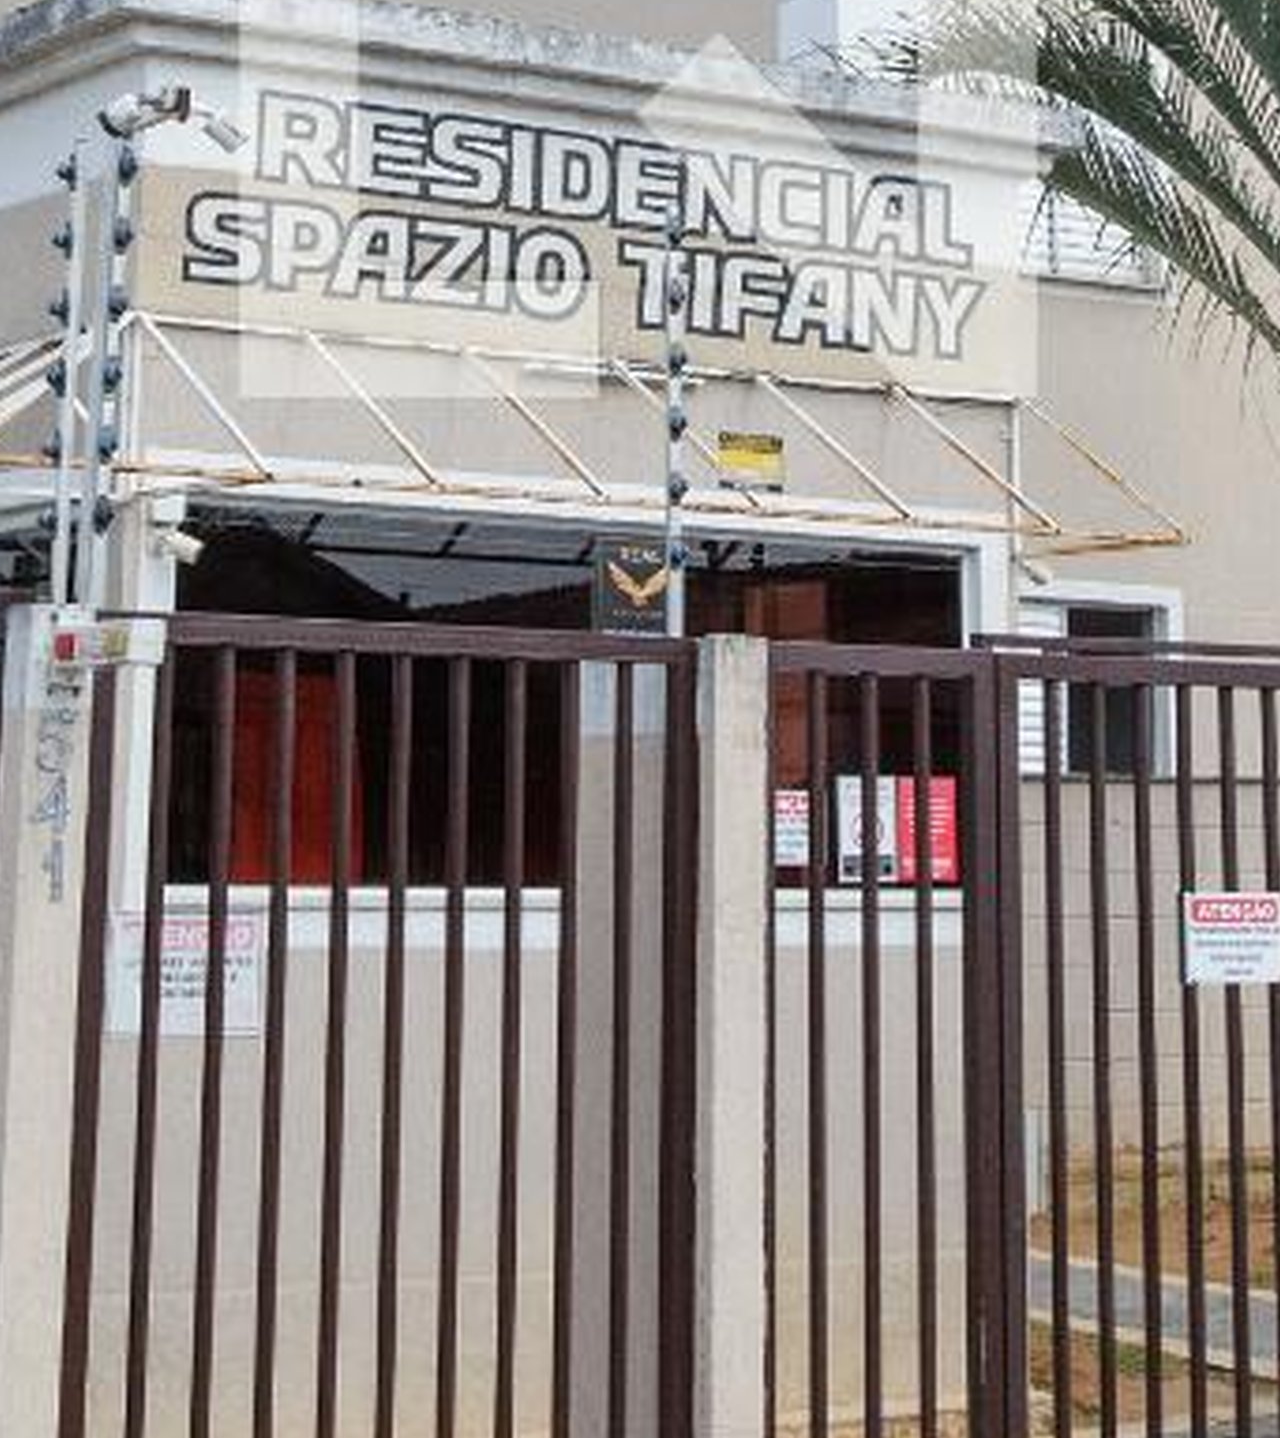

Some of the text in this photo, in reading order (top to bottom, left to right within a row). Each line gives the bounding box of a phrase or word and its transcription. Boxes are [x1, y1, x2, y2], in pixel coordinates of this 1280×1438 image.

[255, 88, 981, 266] RESIDENCIAL
[182, 192, 986, 360] SPAZIO TIFANY
